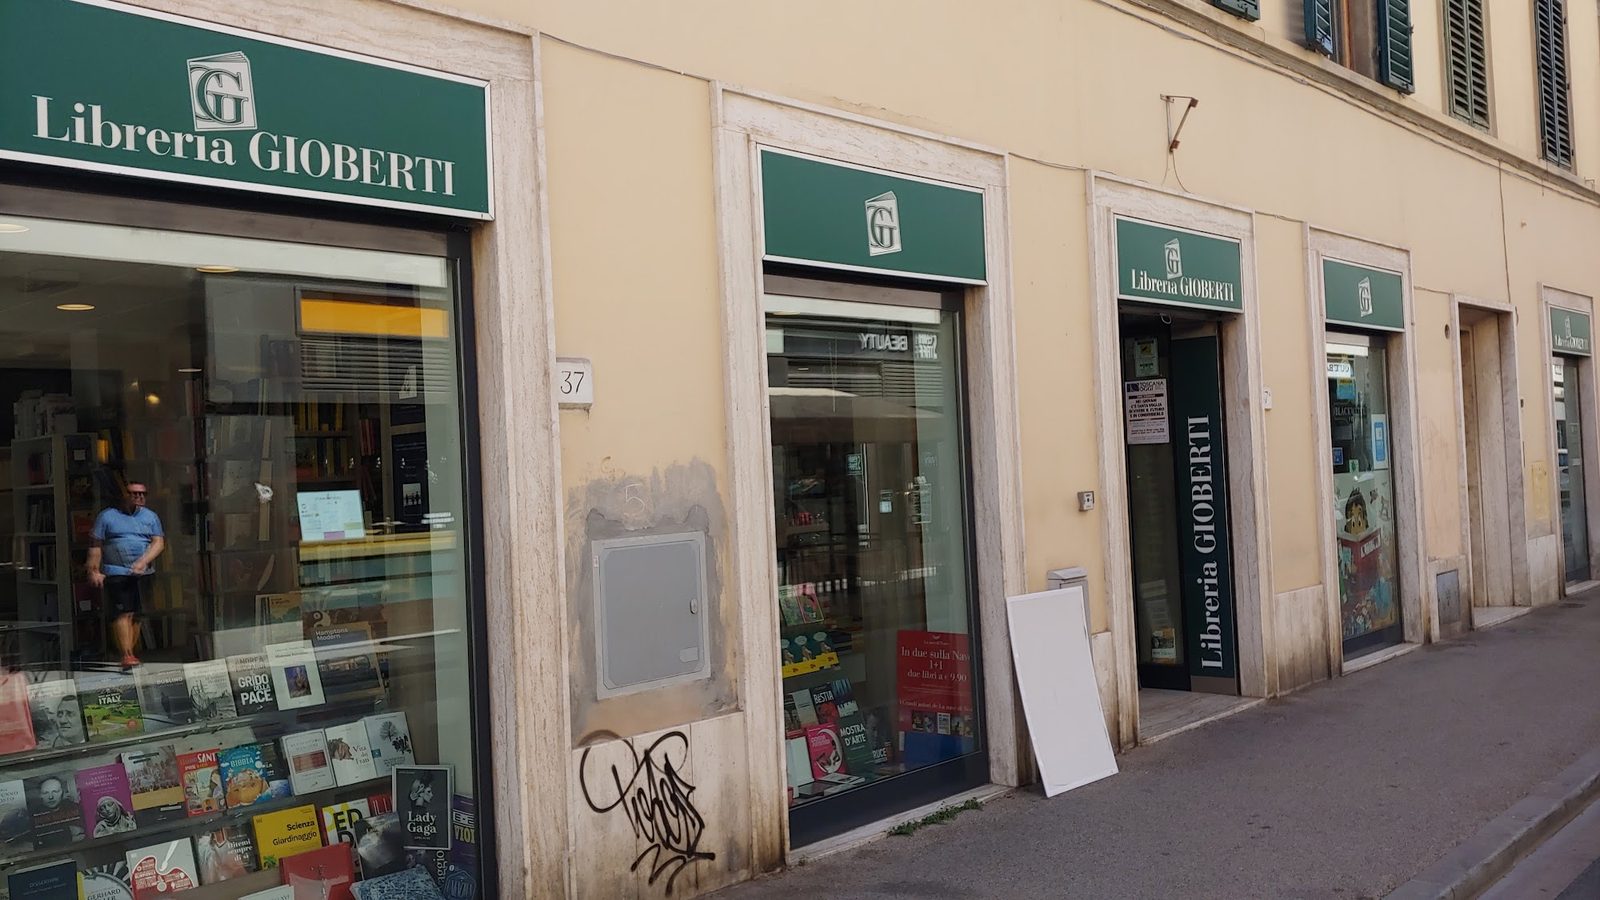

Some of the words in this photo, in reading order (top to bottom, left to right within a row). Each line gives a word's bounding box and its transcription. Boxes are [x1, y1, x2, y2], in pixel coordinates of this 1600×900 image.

[32, 95, 236, 166] Libreria
[249, 131, 456, 196] GIOBERTI
[1131, 268, 1178, 294] Libreria
[1180, 276, 1234, 302] GIOBERTI
[560, 370, 585, 395] 37
[1187, 414, 1217, 554] GIOBERTI
[1196, 561, 1224, 670] Libreria
[315, 627, 348, 637] Hamptons
[901, 646, 910, 656] In
[912, 648, 928, 658] due
[930, 649, 950, 660] sulla
[238, 673, 269, 689] GRIDO
[907, 669, 921, 677] due
[922, 669, 936, 680] libri
[253, 683, 271, 692] DELLA
[98, 694, 122, 705] ITALY
[241, 689, 274, 706] PACE
[813, 690, 834, 704] BESTIA
[840, 723, 866, 737] MOSTRA
[844, 734, 867, 747] D'ARTE
[230, 757, 254, 768] BIBBIA
[286, 819, 316, 831] Scienza
[407, 811, 438, 826] Lady
[407, 822, 438, 837] Gaga
[272, 830, 317, 846] Giardinaggio
[227, 845, 253, 855] sempre
[87, 888, 121, 900] GERHARD
